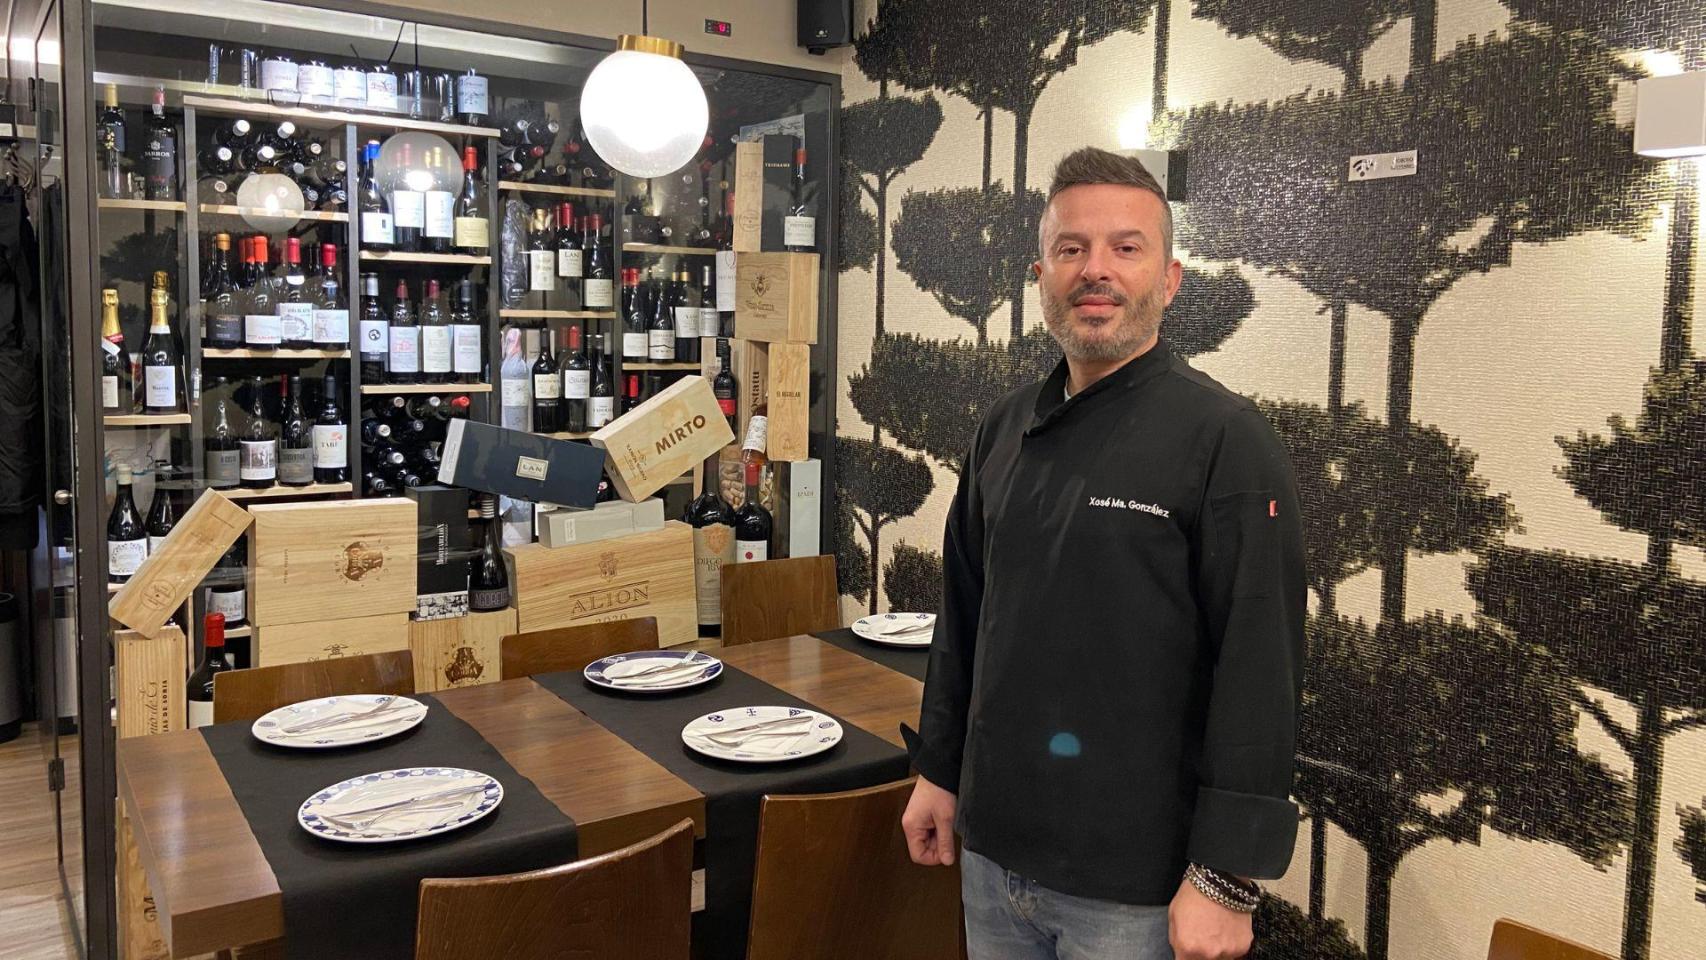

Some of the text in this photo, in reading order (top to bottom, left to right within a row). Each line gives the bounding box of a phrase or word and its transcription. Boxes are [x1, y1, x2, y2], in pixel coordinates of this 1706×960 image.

[655, 415, 706, 455] MIRTO
[522, 463, 542, 473] LAN
[1089, 496, 1170, 518] Xosé Ma. González
[571, 585, 649, 614] ALION
